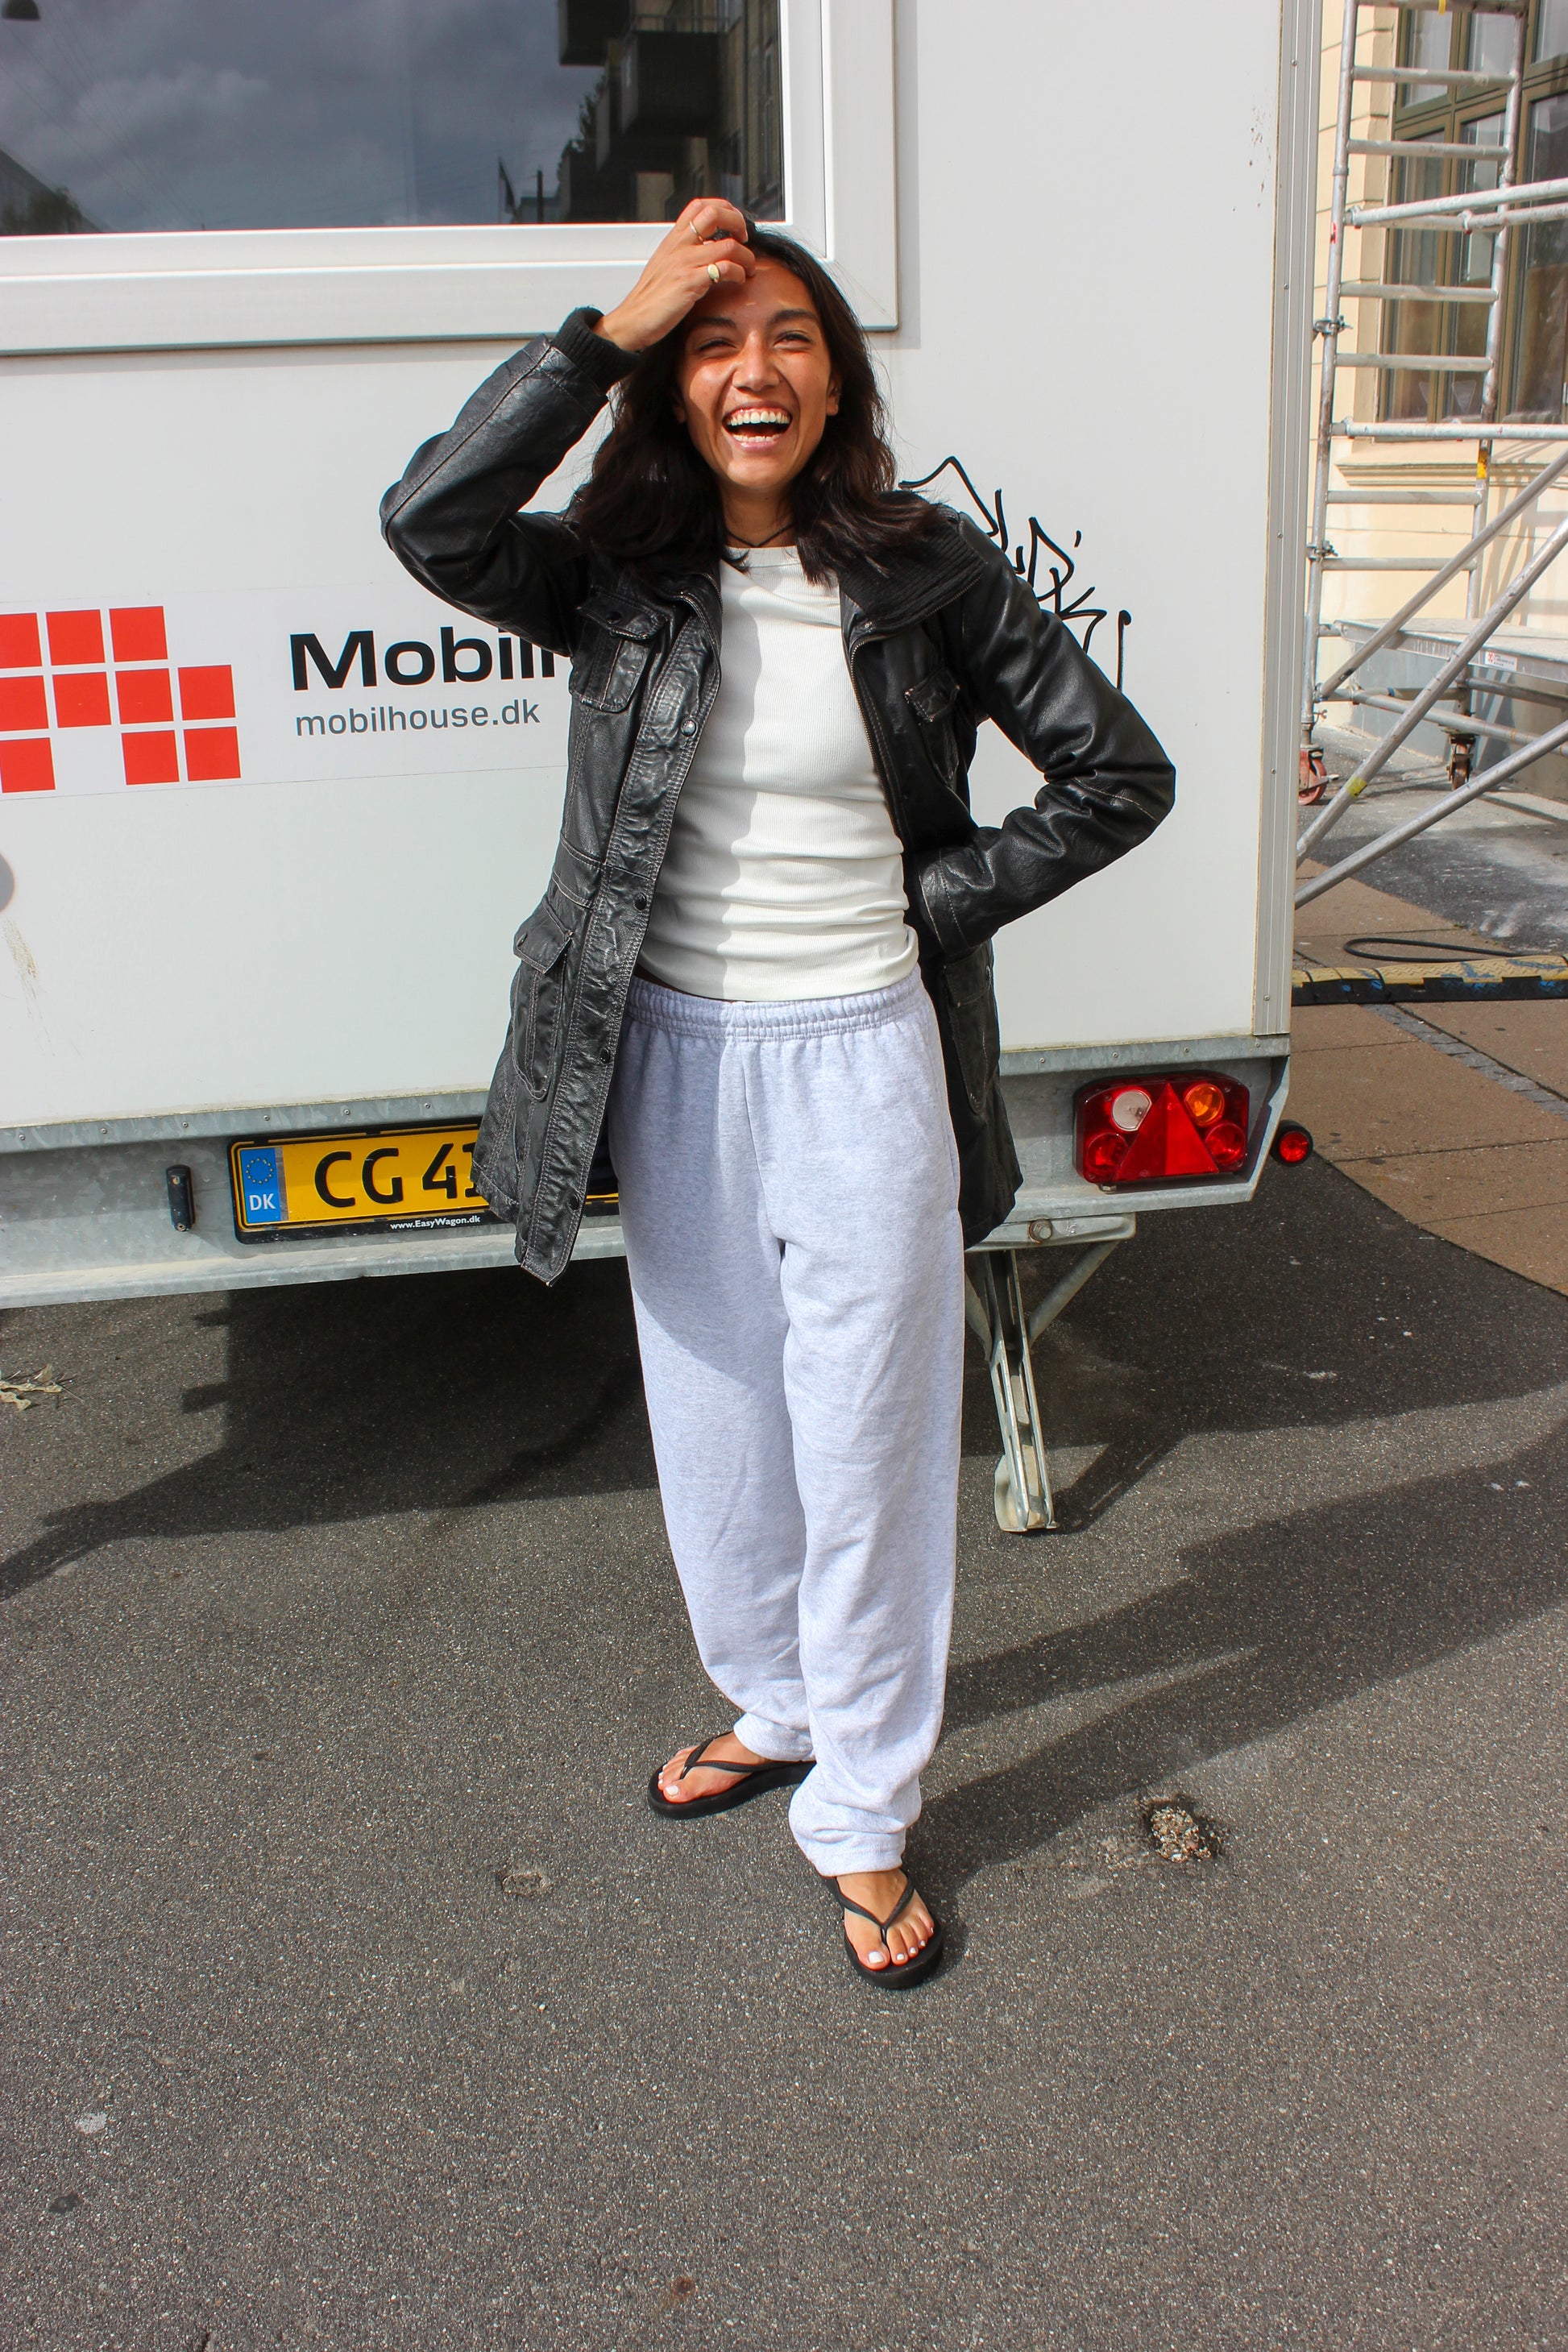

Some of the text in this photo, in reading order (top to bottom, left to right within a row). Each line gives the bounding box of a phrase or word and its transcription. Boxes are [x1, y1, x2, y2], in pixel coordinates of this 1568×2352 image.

[296, 699, 541, 736] mobilhouse.dk
[314, 1147, 404, 1208] CG
[249, 1193, 276, 1212] DK
[390, 1215, 481, 1231] www.EasyWagon.dk
